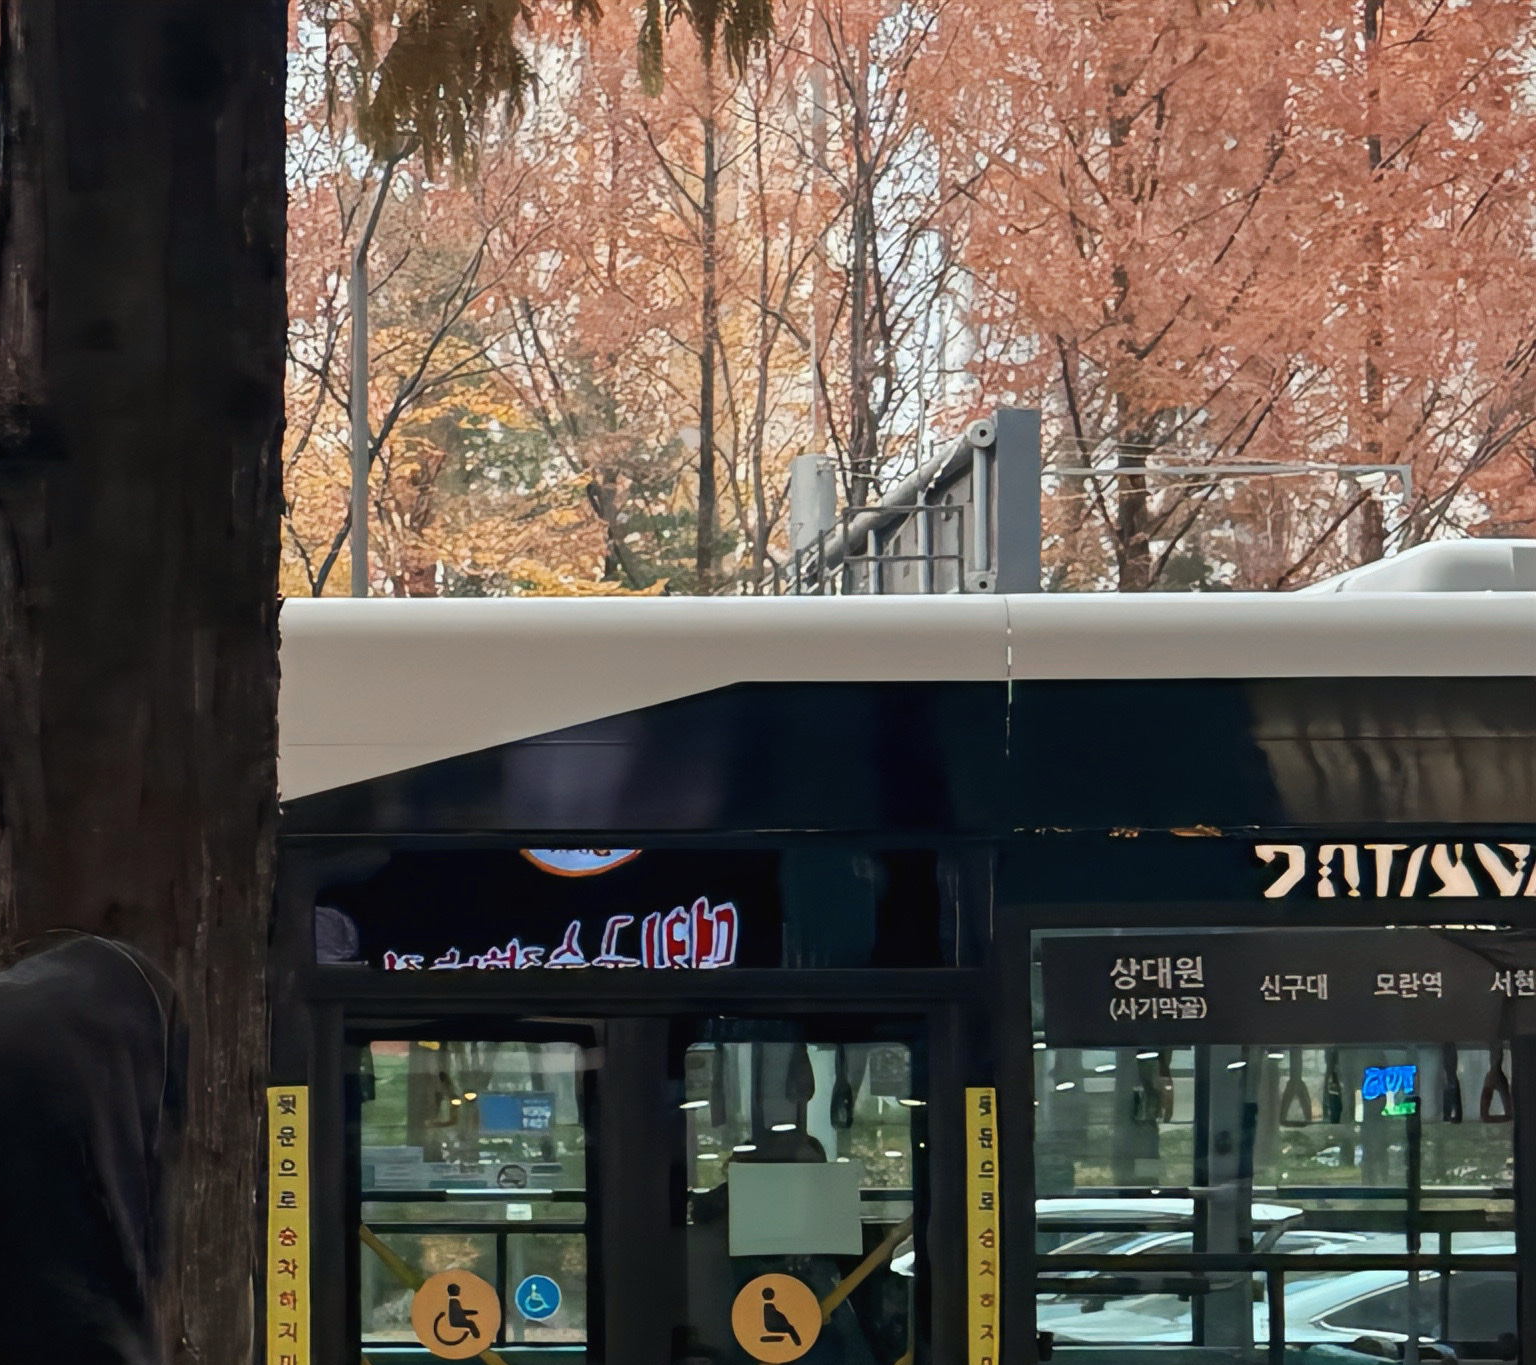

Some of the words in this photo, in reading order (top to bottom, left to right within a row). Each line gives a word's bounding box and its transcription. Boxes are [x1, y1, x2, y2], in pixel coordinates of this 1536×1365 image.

[1109, 956, 1205, 989] 상대원
[1373, 972, 1443, 999] 모란역
[1259, 973, 1329, 1000] 신구대
